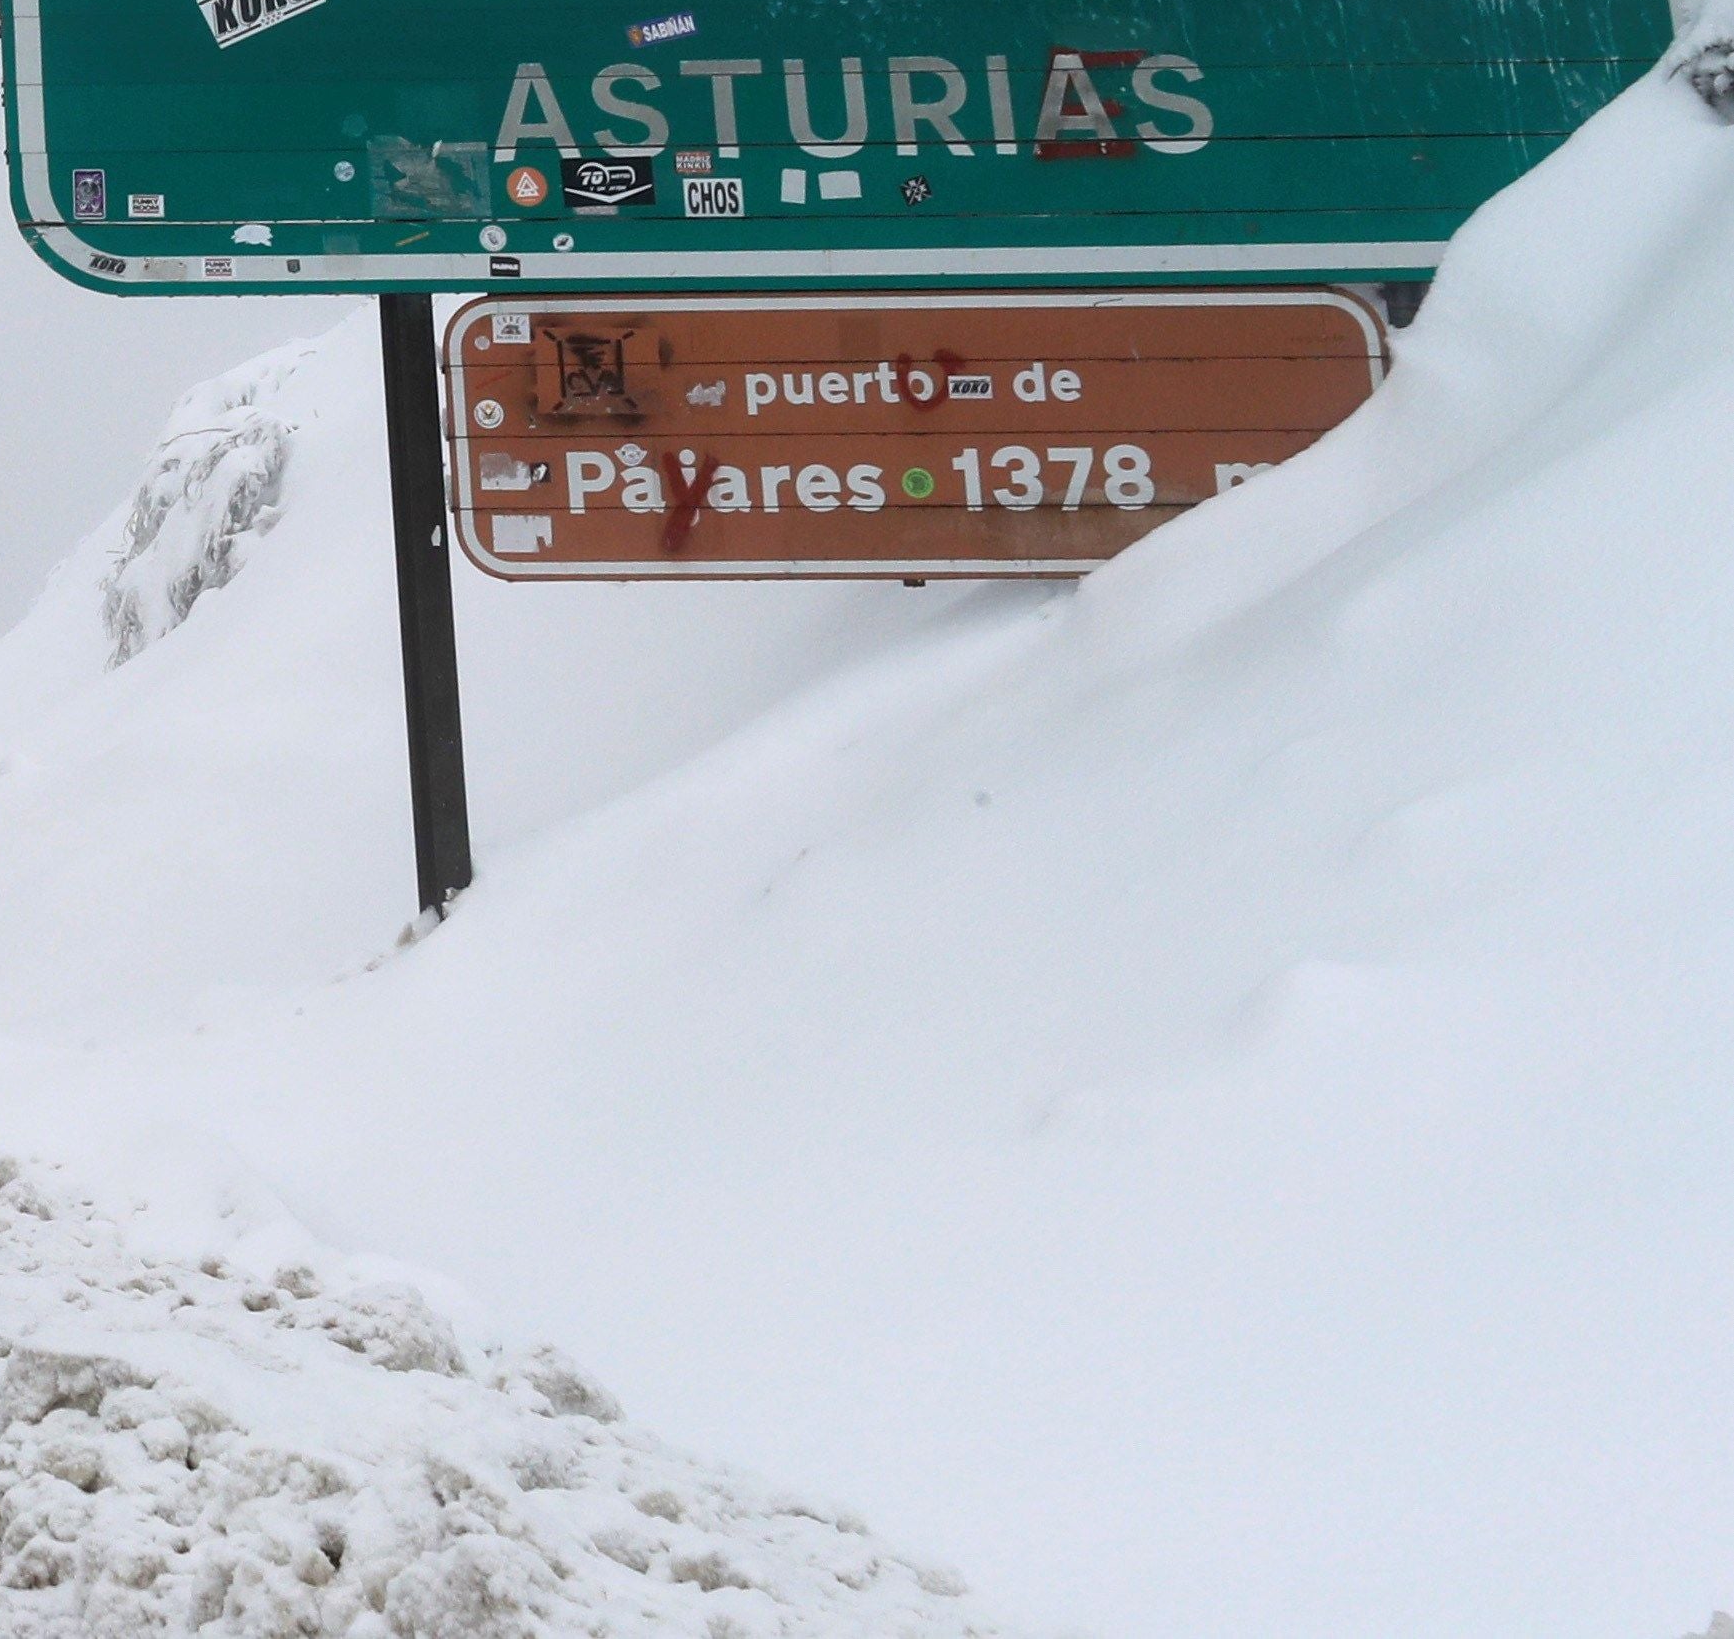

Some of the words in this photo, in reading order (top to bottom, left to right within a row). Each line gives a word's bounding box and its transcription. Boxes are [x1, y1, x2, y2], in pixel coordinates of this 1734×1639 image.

[493, 51, 1216, 164] ASTURIAS
[580, 170, 605, 186] 70
[687, 181, 740, 215] CHOS
[89, 253, 127, 274] KOKO
[745, 361, 934, 415] puerto
[1013, 362, 1082, 403] de
[950, 380, 990, 394] KOKO
[951, 444, 1155, 512] 1378
